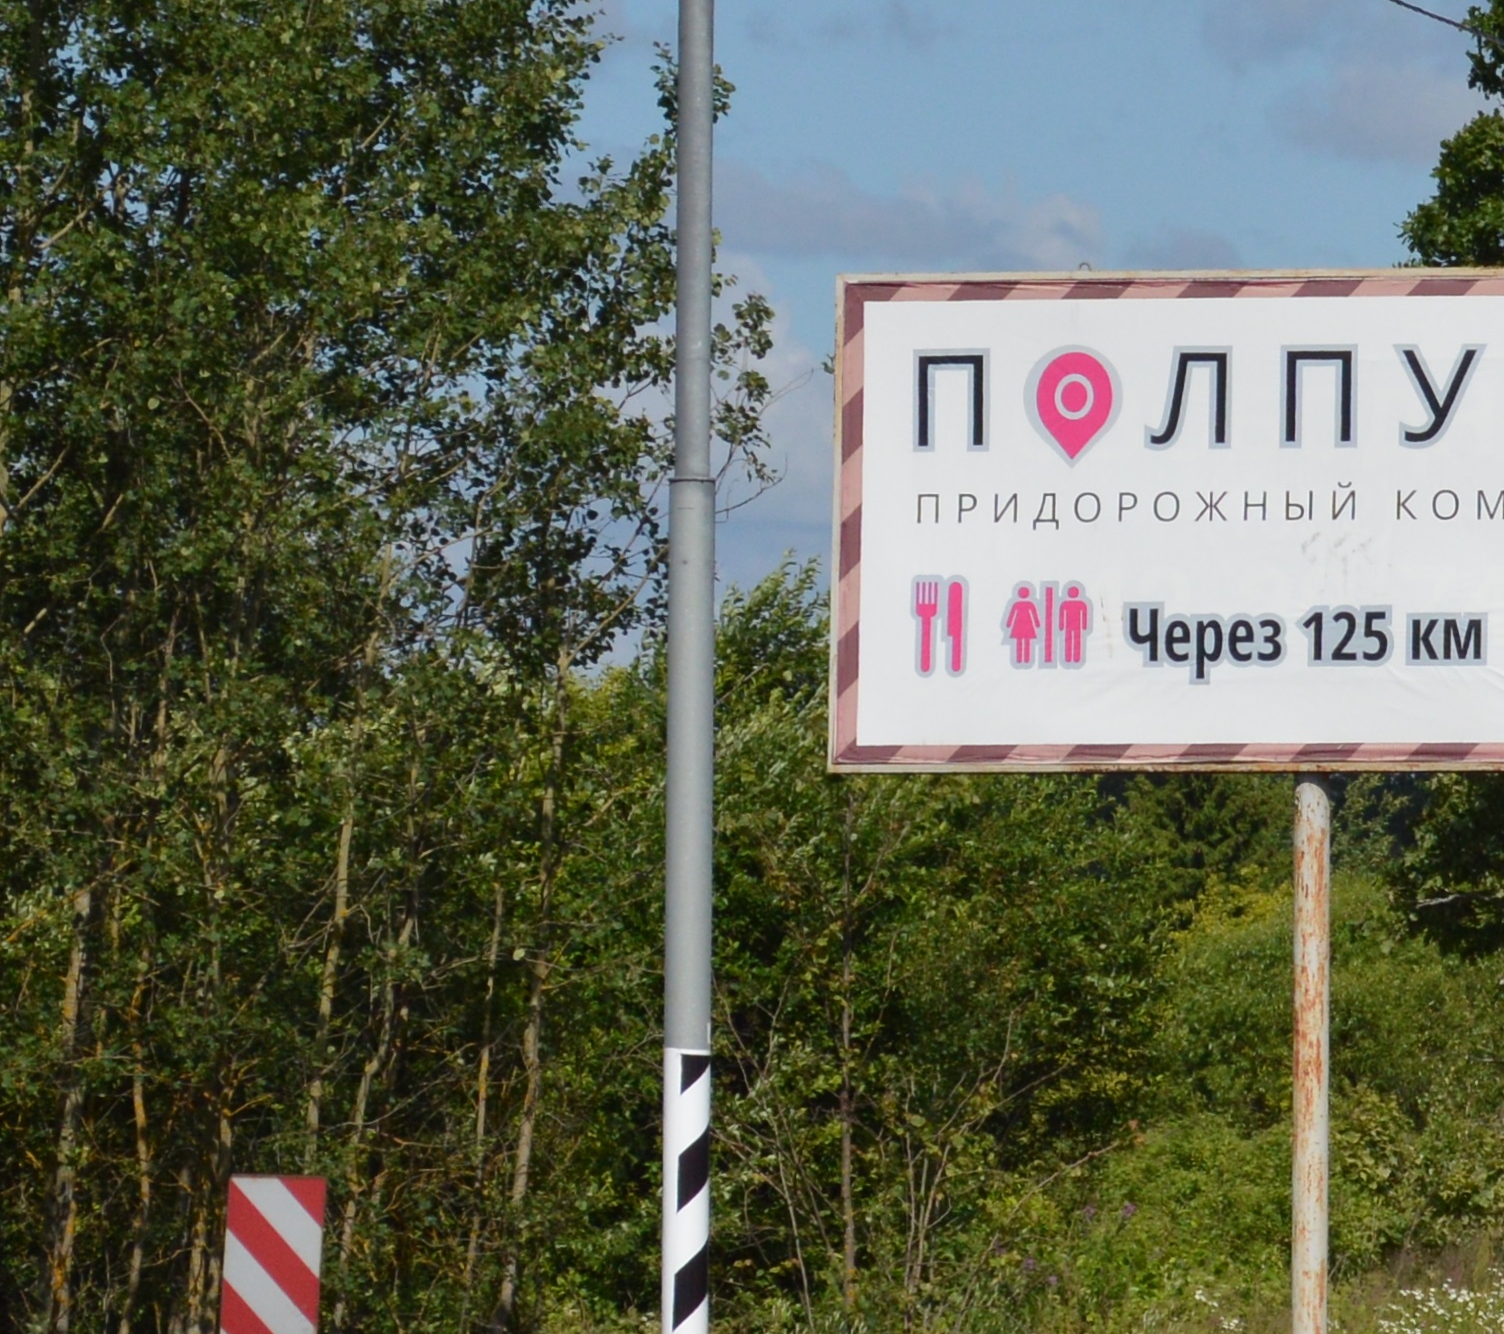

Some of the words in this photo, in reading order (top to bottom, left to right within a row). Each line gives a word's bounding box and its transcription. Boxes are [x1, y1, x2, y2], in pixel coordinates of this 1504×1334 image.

[916, 482, 1357, 531] ПРИДОРОЖНЫЙ
[1130, 607, 1282, 679] Через
[1303, 611, 1388, 661] 125
[1412, 618, 1482, 661] км
